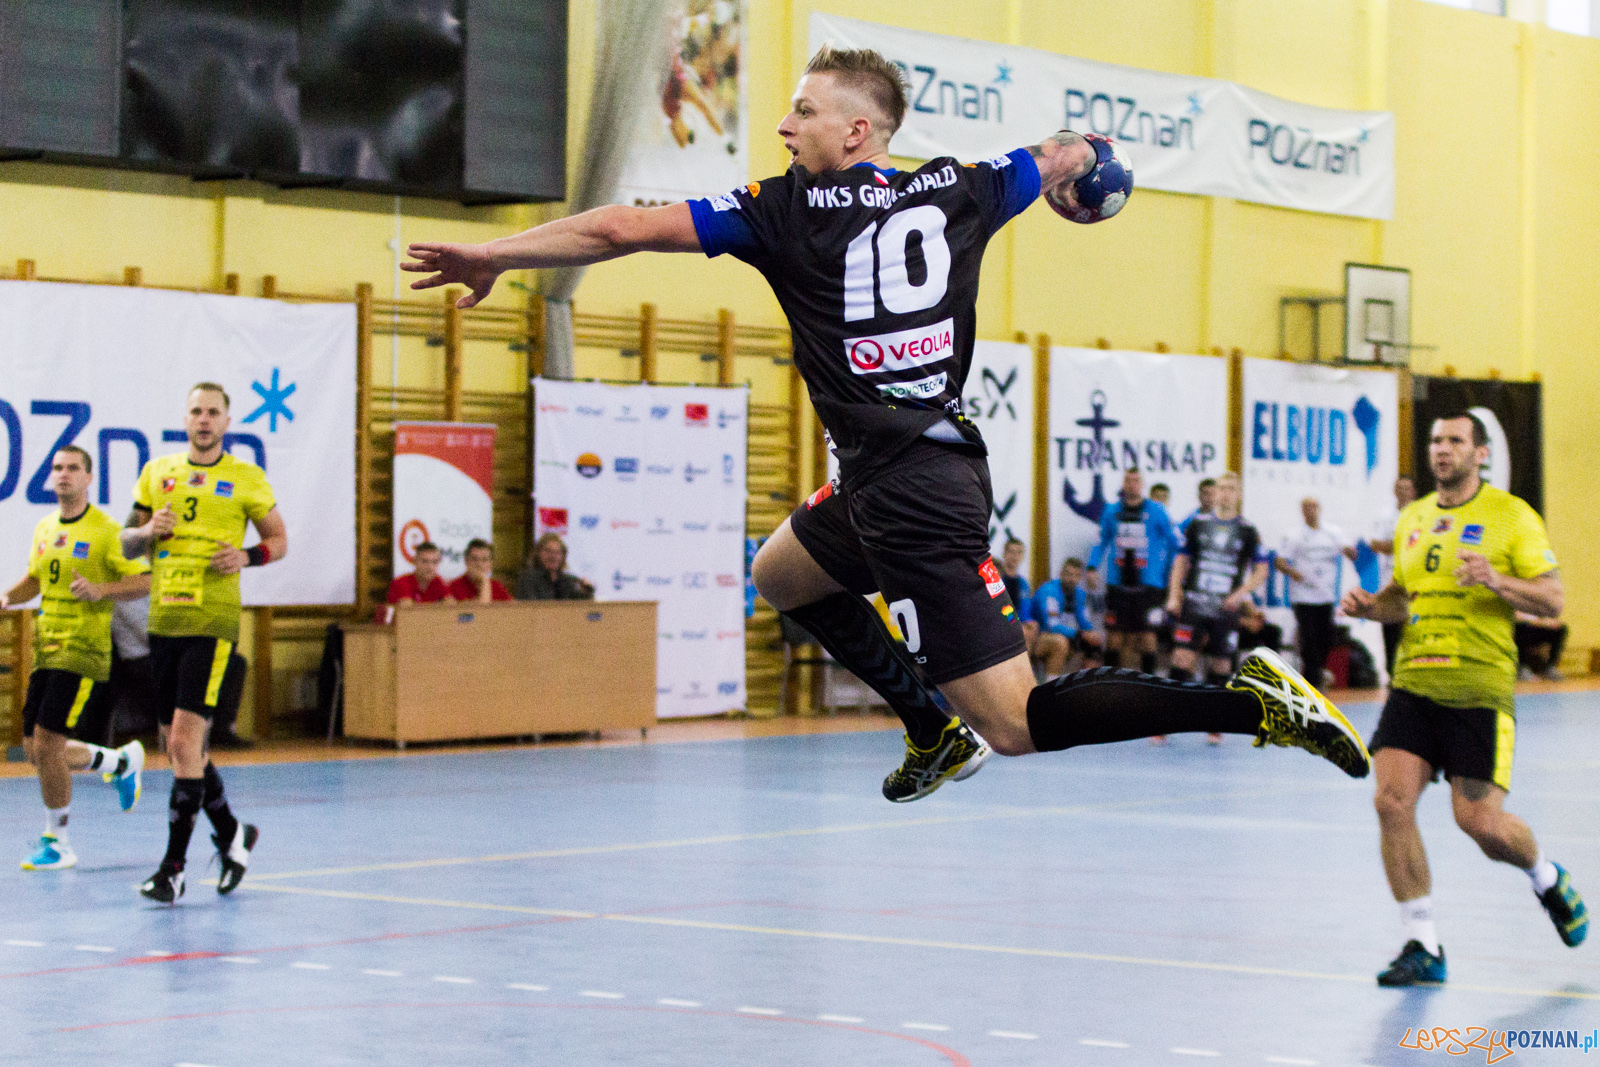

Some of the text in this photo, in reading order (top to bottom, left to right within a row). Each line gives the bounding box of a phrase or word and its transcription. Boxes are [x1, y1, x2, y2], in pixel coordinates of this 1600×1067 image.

[806, 187, 853, 208] WKS
[844, 204, 951, 322] 10
[888, 331, 951, 361] VEOLIA
[1252, 400, 1348, 466] ELBUD
[1054, 437, 1216, 473] TRANSKAP
[183, 497, 198, 522] 3
[49, 559, 60, 584] 9
[1425, 544, 1442, 573] 6
